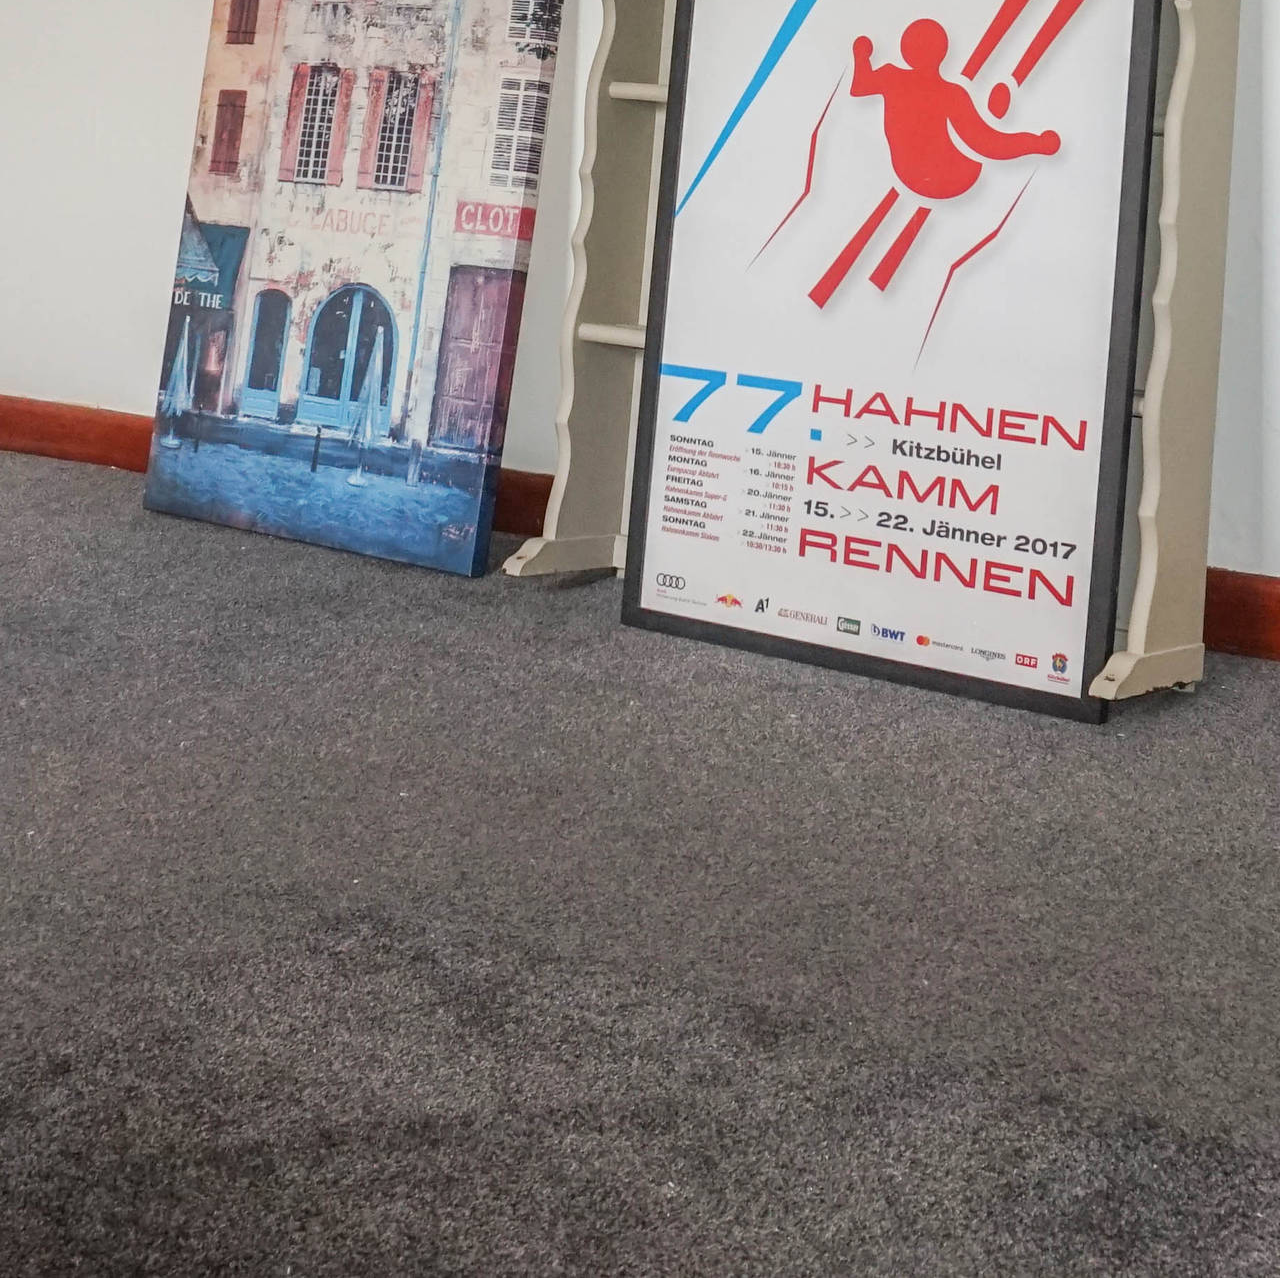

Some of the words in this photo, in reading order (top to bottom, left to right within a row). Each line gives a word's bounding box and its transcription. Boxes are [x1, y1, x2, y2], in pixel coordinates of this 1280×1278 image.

[461, 205, 519, 233] CLOT
[174, 290, 191, 306] DE
[199, 291, 224, 309] THE
[811, 383, 1088, 451] HAHNEN
[670, 434, 714, 448] SONNTAG
[667, 454, 708, 468] MONTAG
[766, 449, 797, 461] Jänner
[891, 438, 1003, 471] Kitzbühel
[665, 474, 704, 488] FREITAG
[765, 470, 795, 482] Jänner
[805, 455, 1000, 516] KAMM
[664, 494, 708, 509] SAMSTAG
[662, 514, 706, 529] SONNTAG
[760, 510, 789, 523] Jänner
[803, 500, 835, 519] 15.
[875, 511, 915, 534] 22.
[922, 519, 1007, 549] Jänner
[1013, 535, 1078, 561] 2017
[798, 528, 1074, 608] RENNEN
[789, 610, 829, 626] GENERALI
[881, 627, 906, 642] BWT
[970, 646, 1006, 660] LONGINES
[1016, 655, 1037, 667] ORF
